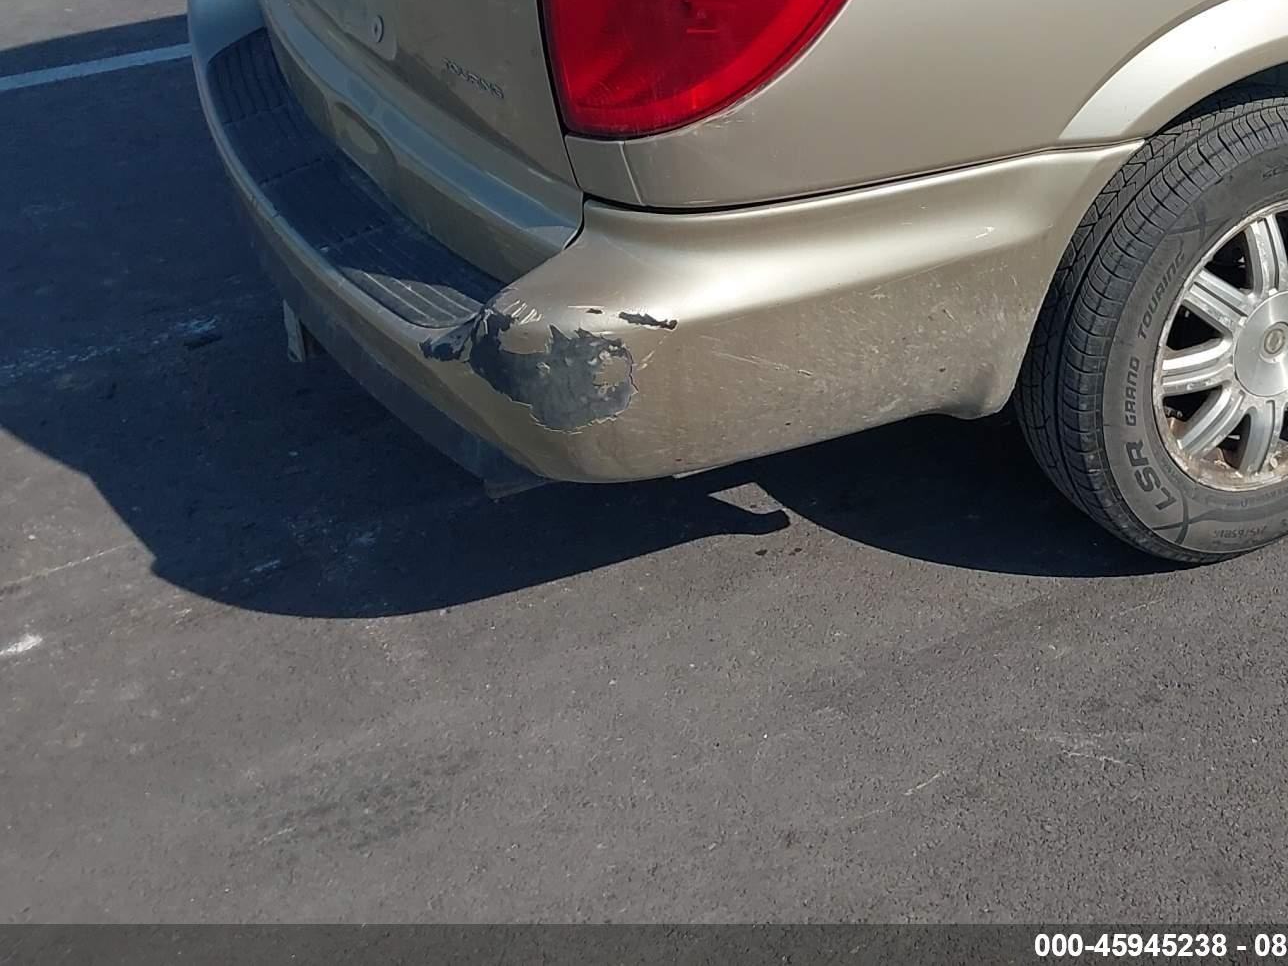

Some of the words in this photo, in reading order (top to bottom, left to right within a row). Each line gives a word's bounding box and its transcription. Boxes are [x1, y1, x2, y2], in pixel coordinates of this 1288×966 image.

[1137, 248, 1186, 341] TOURING
[1124, 356, 1141, 427] GRAND
[1125, 440, 1177, 511] LSR
